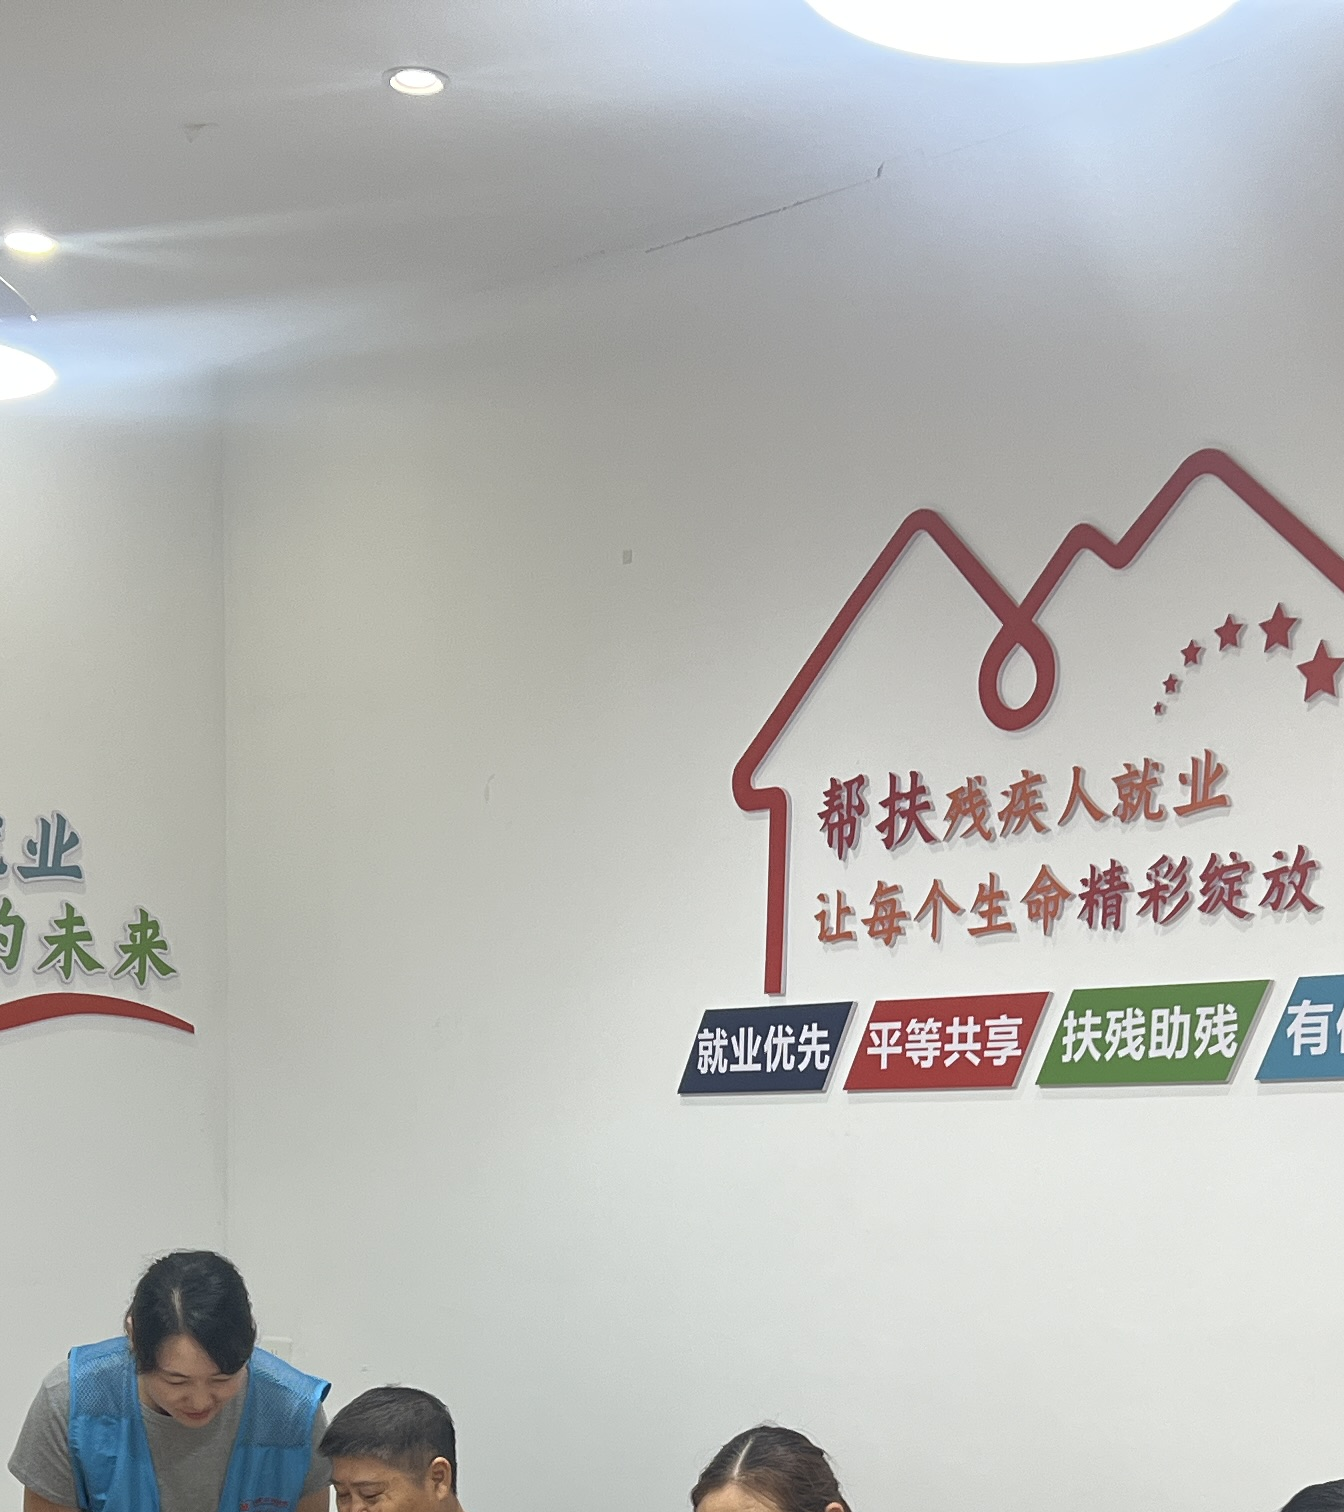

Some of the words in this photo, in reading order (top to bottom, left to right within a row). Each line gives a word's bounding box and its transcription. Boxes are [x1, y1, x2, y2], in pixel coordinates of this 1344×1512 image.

[818, 748, 1233, 860] 帮扶残疾人就业
[815, 844, 1324, 947] 让每个生命精彩绽放
[697, 1026, 831, 1075] 就业优先
[866, 1012, 1024, 1070] 平等共享
[1061, 1006, 1240, 1060] 扶残助残
